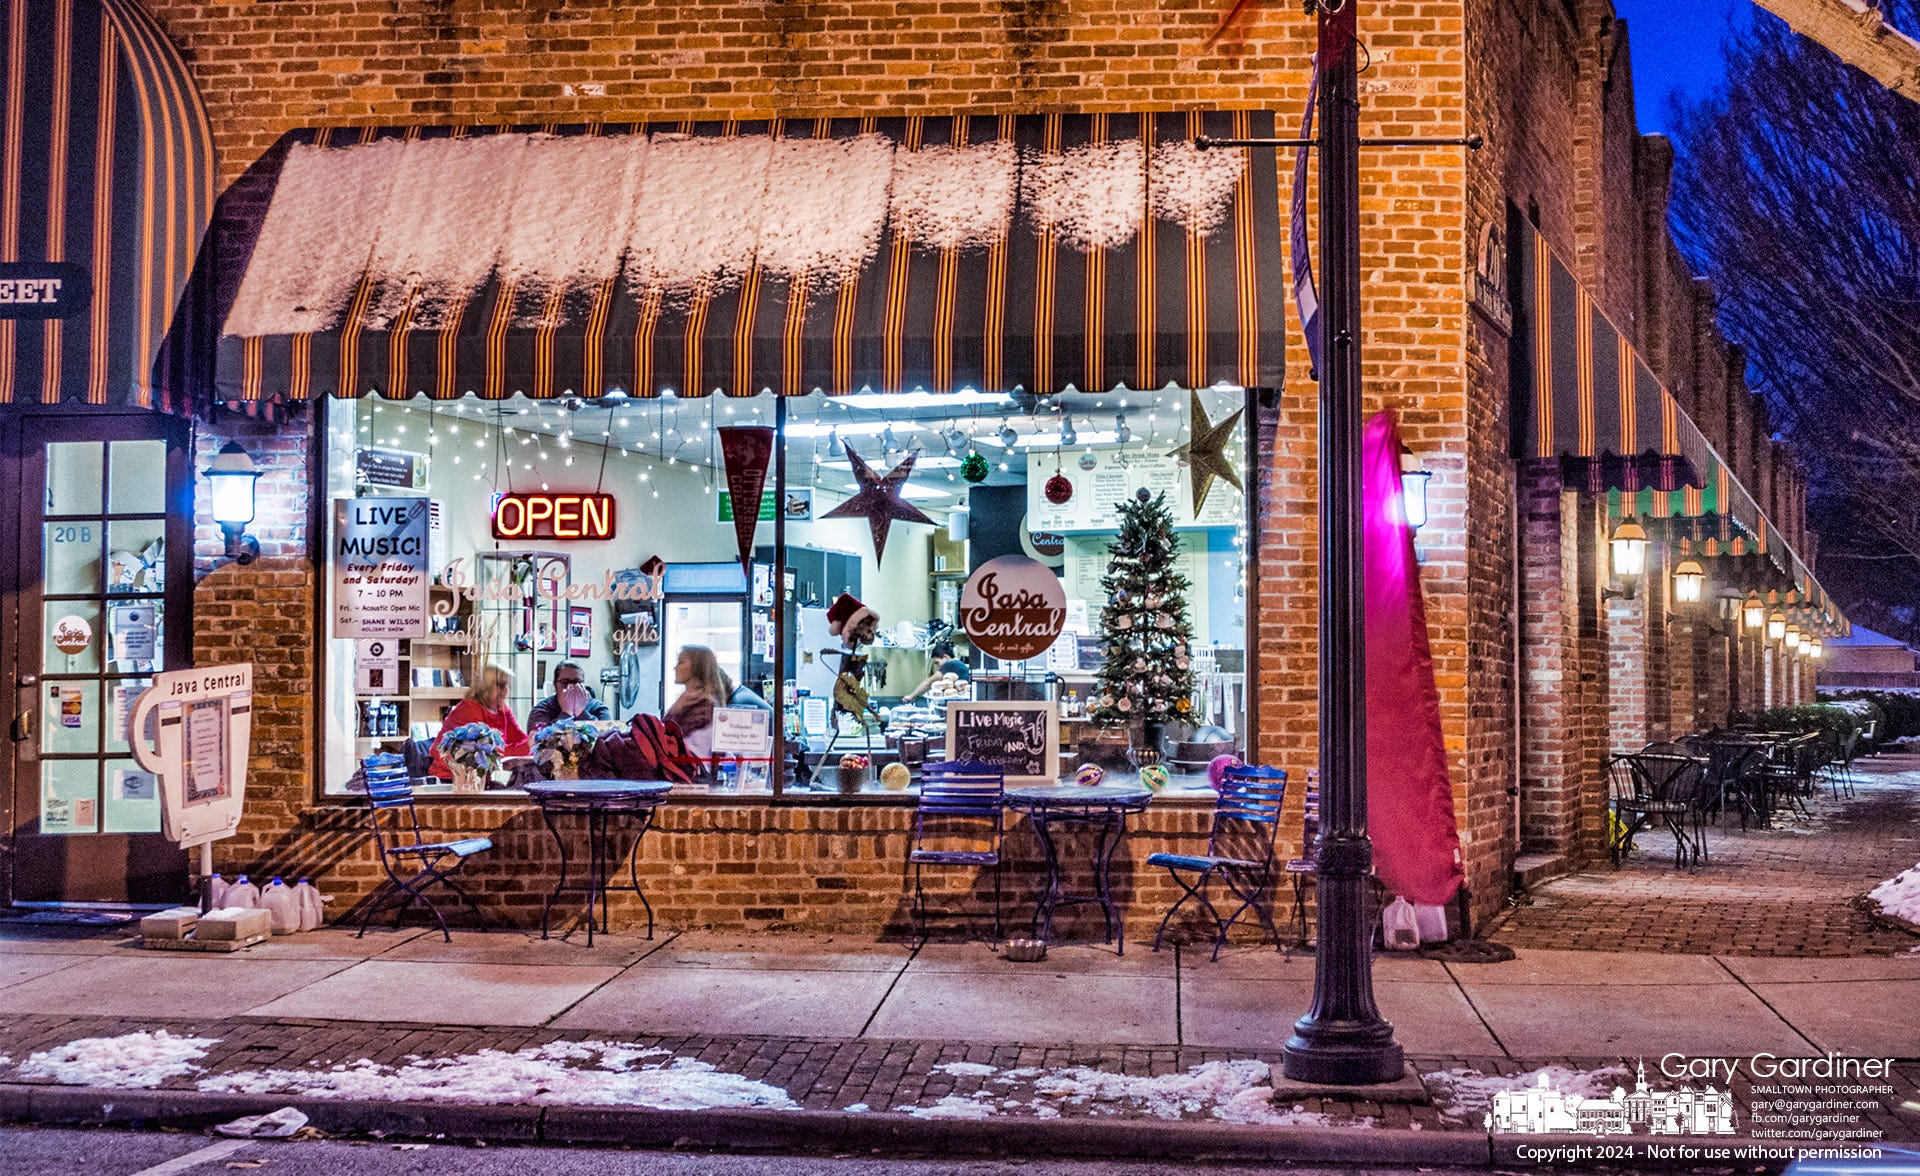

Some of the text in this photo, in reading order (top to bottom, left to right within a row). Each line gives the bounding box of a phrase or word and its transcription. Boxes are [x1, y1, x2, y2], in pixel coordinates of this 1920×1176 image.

[356, 507, 407, 525] LIVE
[498, 498, 608, 535] OPEN
[54, 526, 92, 543] 20 B
[340, 537, 421, 556] MUSIC!
[347, 563, 415, 573] Every Friday
[343, 575, 419, 586] and Saturday!
[434, 556, 665, 617] Java Central
[357, 589, 363, 597] 7
[376, 589, 386, 597] 10
[389, 589, 403, 597] PM
[977, 572, 1048, 623] Java
[390, 605, 407, 613] Open
[966, 607, 1061, 637] Central
[612, 613, 660, 656] gifts
[170, 672, 245, 696] Java Central
[959, 711, 1025, 728] Live Music
